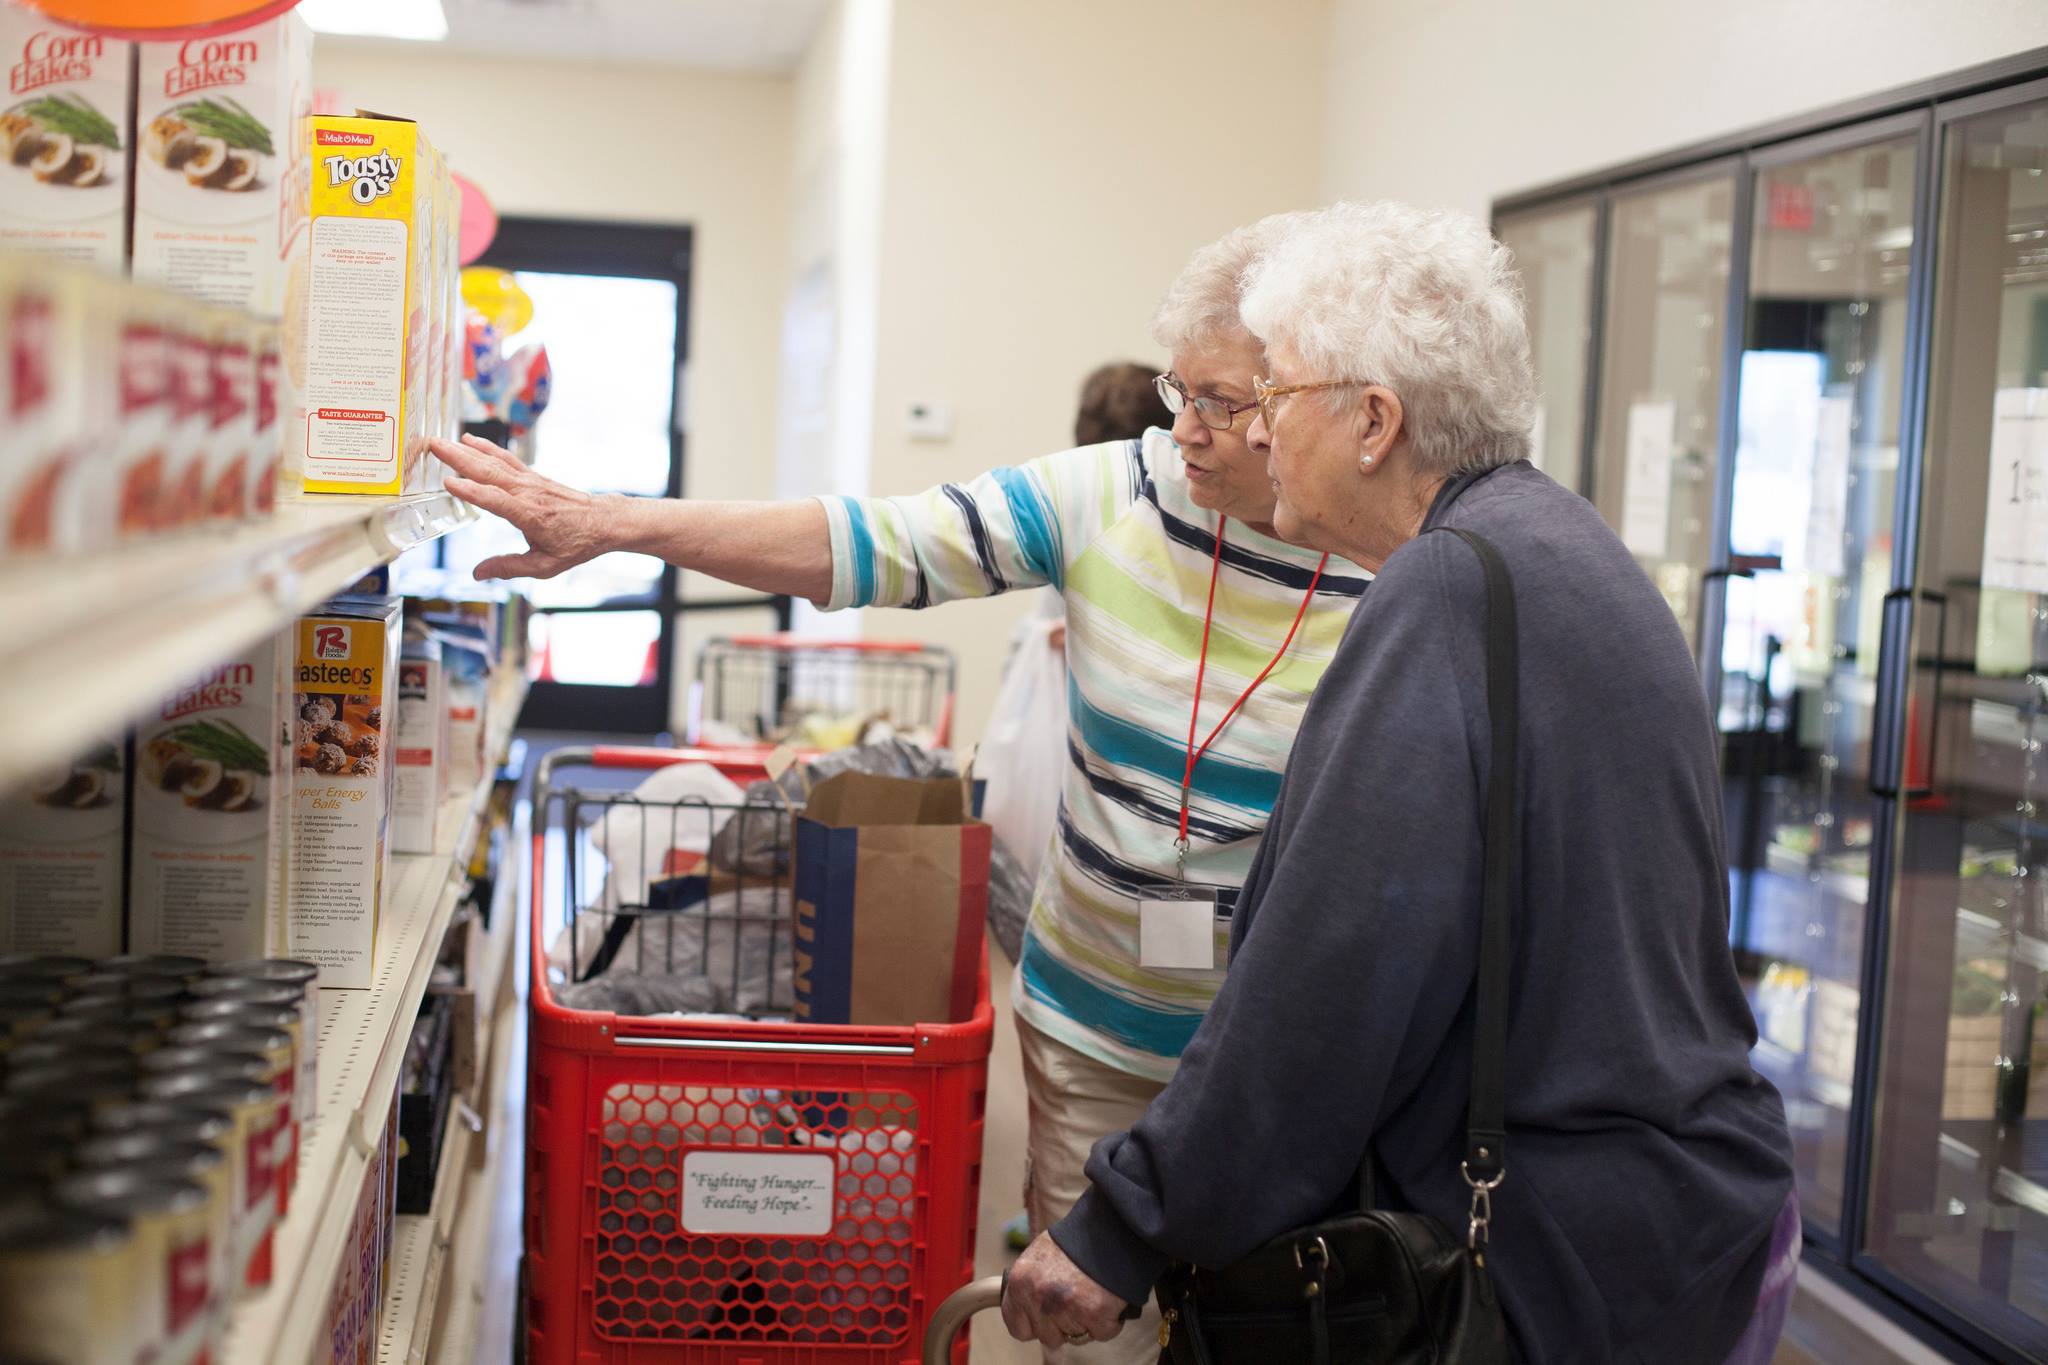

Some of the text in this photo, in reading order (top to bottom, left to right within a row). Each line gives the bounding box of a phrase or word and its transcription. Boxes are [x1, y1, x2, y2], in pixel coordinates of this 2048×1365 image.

[22, 31, 102, 64] Corn
[178, 39, 257, 68] Corn
[10, 58, 92, 95] Flakes
[164, 63, 246, 98] Flakes
[324, 148, 402, 187] Toasty
[351, 175, 392, 204] O's
[343, 412, 383, 420] GUARANTEE
[299, 660, 373, 685] asteeos
[312, 799, 342, 810] Balls
[326, 787, 368, 801] Energy
[702, 1194, 759, 1214] Feeding
